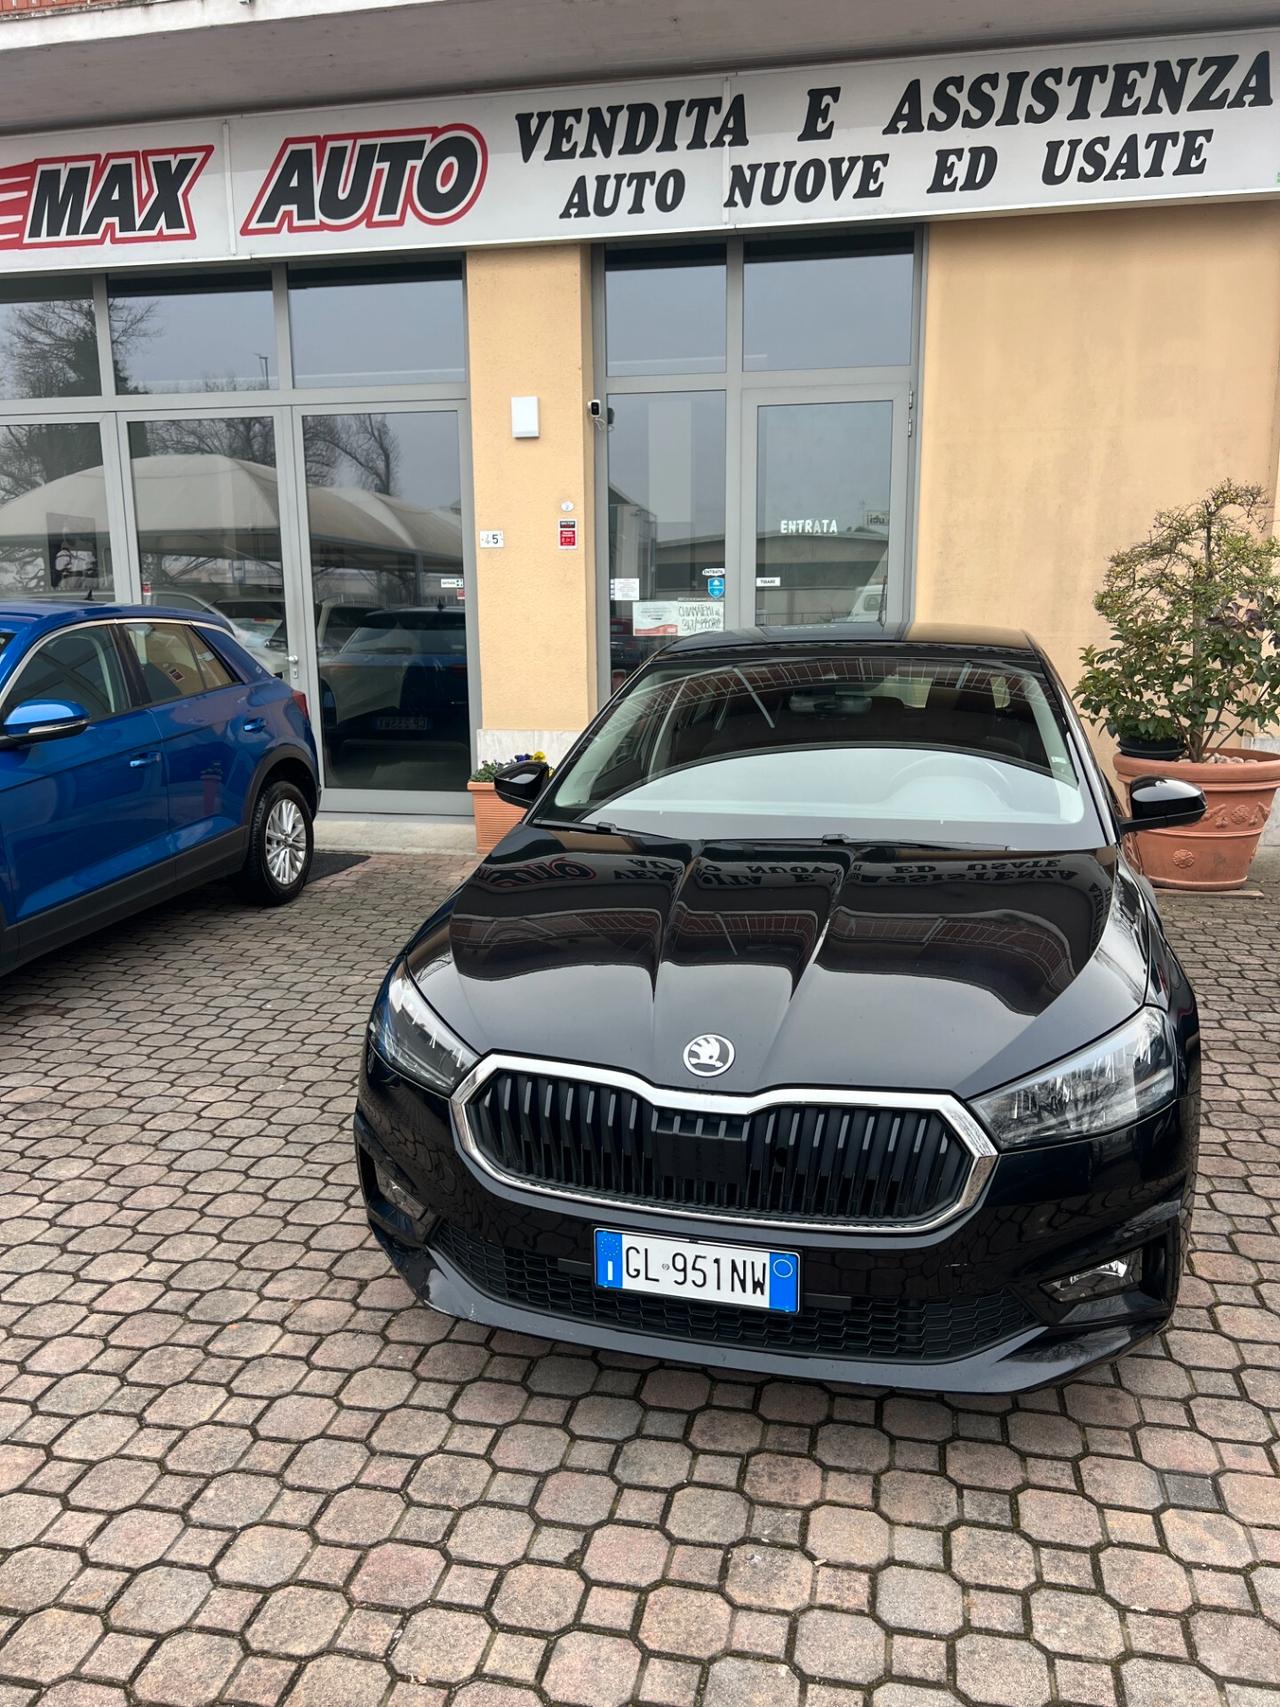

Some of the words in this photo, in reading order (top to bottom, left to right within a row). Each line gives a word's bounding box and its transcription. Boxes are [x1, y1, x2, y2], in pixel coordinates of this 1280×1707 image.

[515, 94, 750, 164] VENDITA
[797, 86, 842, 142] E
[883, 51, 1274, 136] ASSISTENZA
[26, 153, 203, 240] MAX
[252, 132, 482, 227] AUTO
[559, 169, 687, 218] AUTO
[724, 154, 890, 209] NUOVE
[926, 146, 998, 197] ED
[1041, 129, 1214, 187] USATE
[780, 519, 838, 534] ENTRATA
